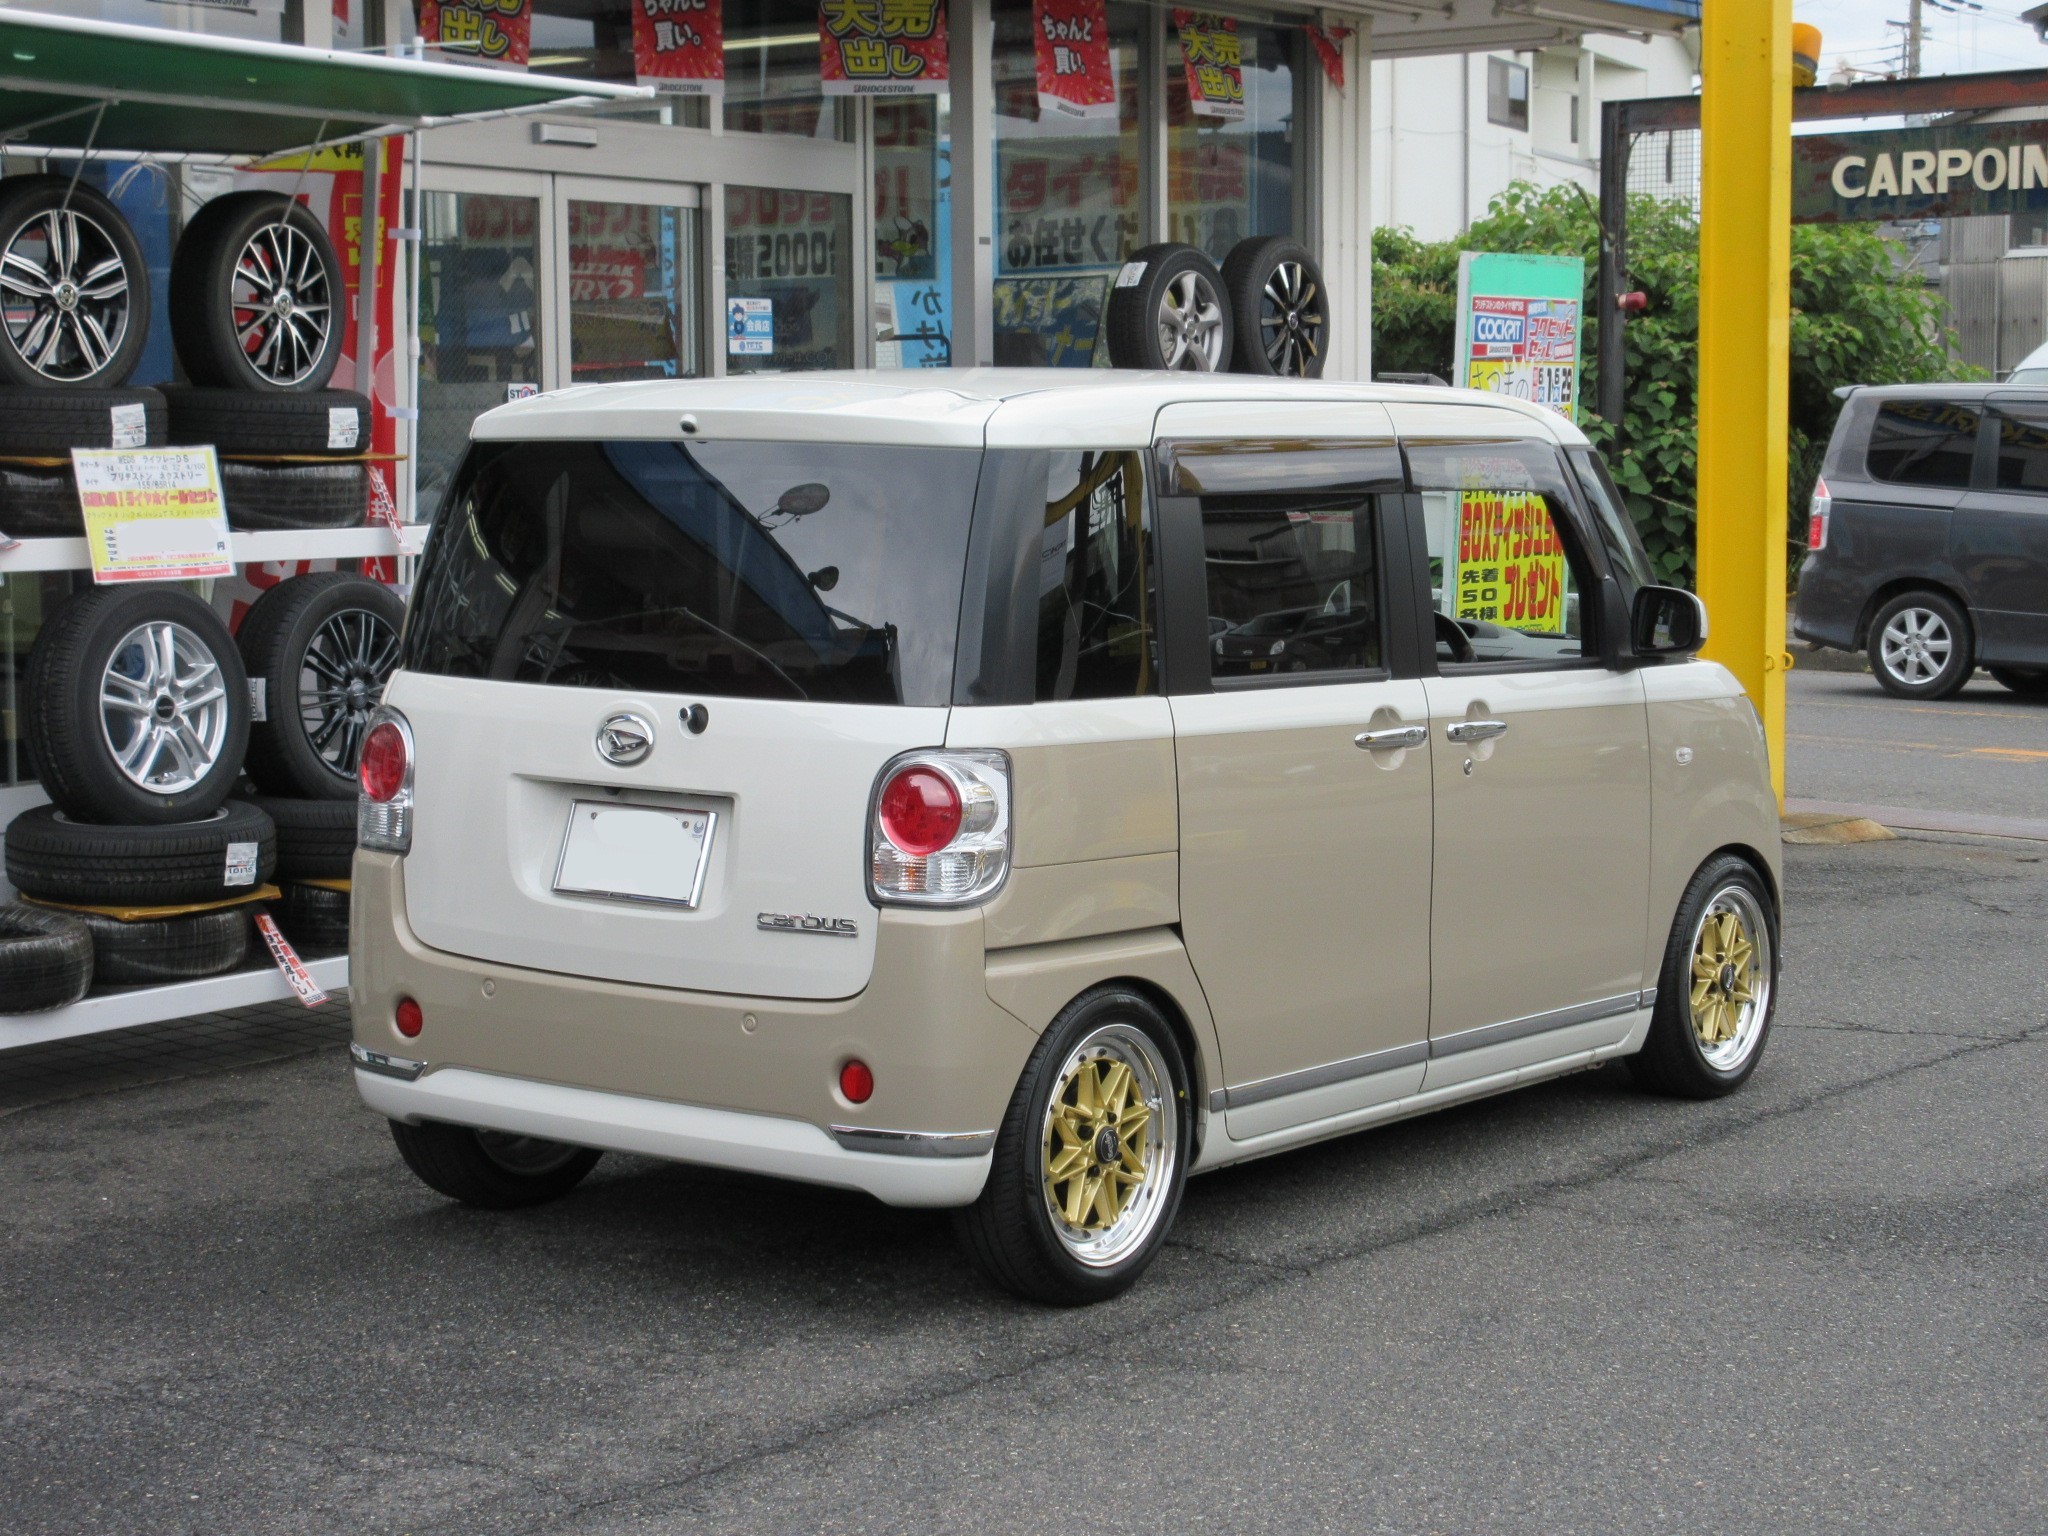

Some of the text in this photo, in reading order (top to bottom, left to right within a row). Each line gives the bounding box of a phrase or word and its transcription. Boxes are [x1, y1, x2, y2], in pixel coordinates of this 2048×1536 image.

[440, 7, 510, 56] 出し
[1041, 14, 1092, 42] ちゃんと
[841, 38, 925, 79] 出し
[853, 83, 915, 94] BRIDGESTONE
[1197, 65, 1245, 101] 出し
[1831, 144, 2048, 199] CARPOIN
[1477, 317, 1522, 341] COCKPIT
[1461, 568, 1499, 585] 先着
[1503, 558, 1560, 621] プレゼント
[1462, 588, 1498, 603] 50
[1460, 606, 1498, 621] 名様
[757, 912, 858, 932] canbus
